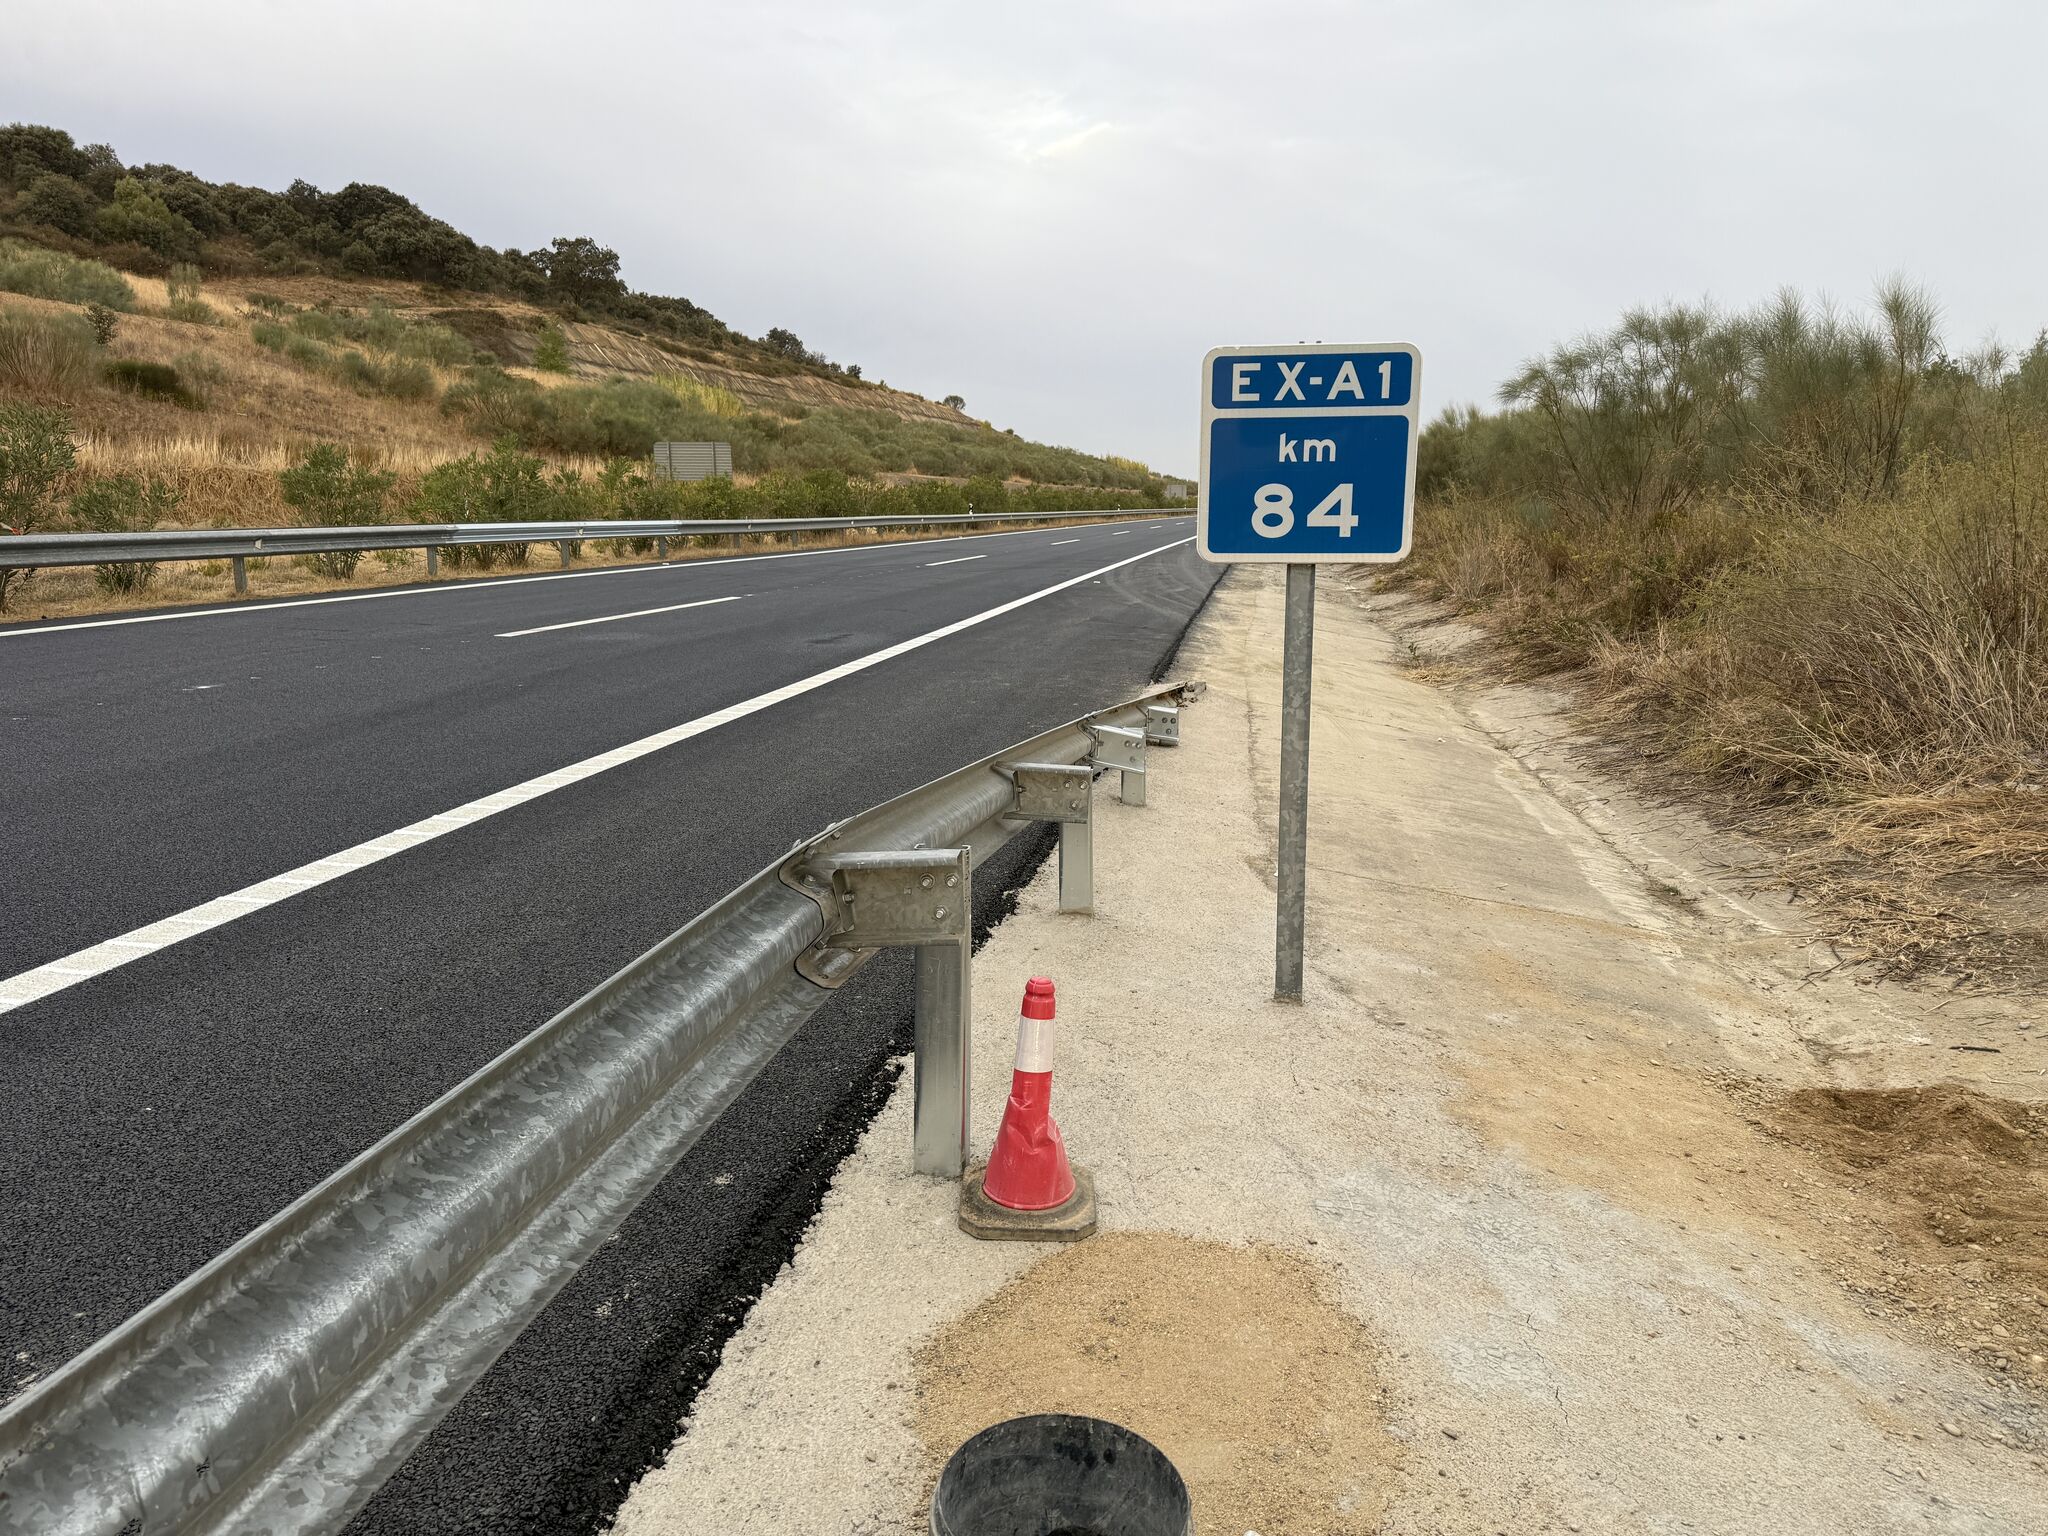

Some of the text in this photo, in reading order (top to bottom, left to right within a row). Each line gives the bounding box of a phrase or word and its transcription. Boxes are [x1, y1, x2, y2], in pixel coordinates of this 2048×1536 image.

[1231, 360, 1392, 402] EX-A1
[1278, 432, 1337, 463] km
[1251, 483, 1359, 539] 84
